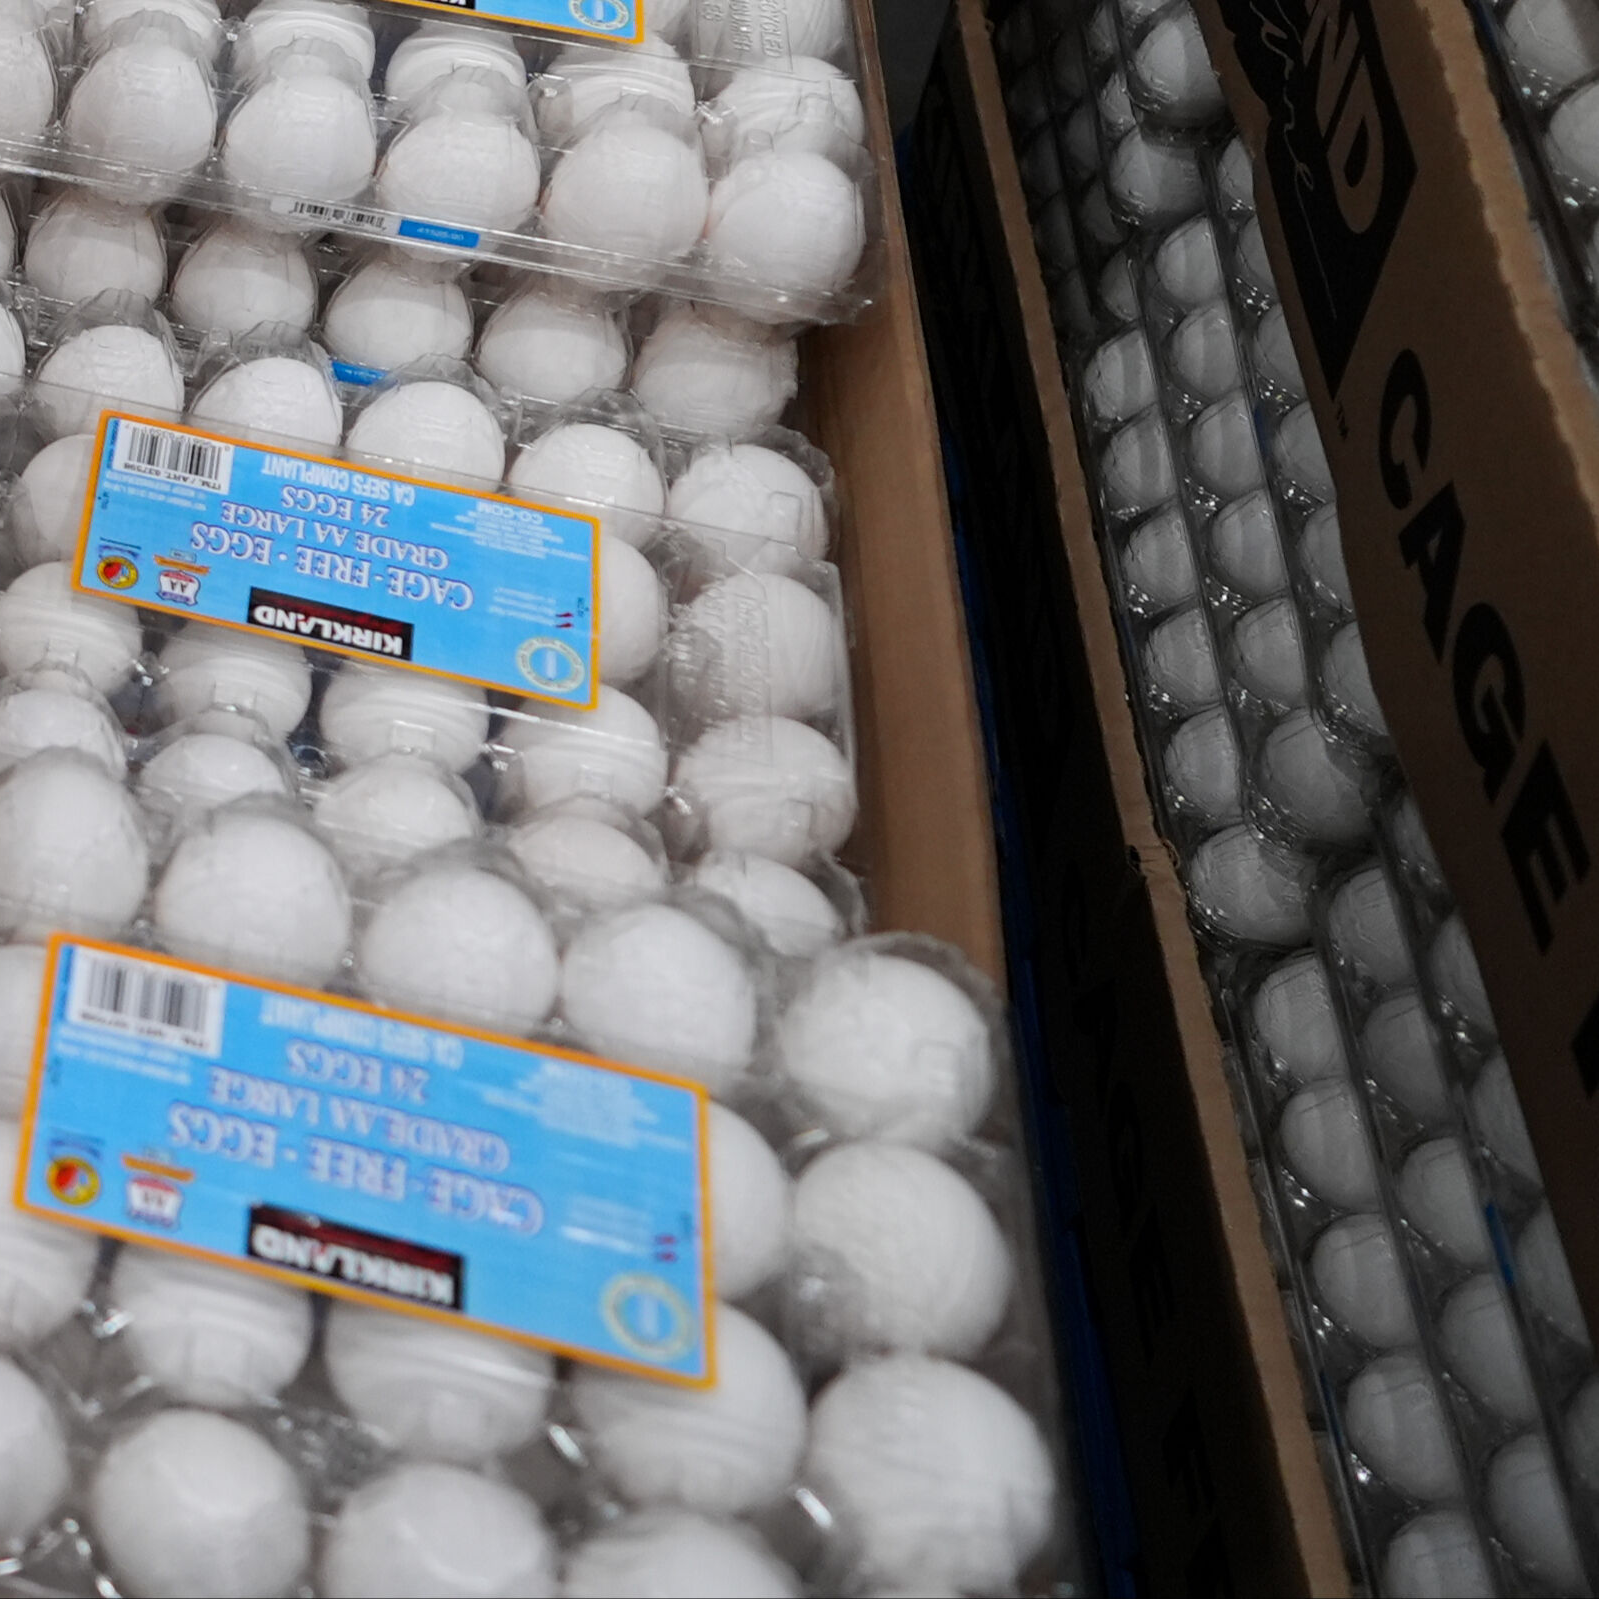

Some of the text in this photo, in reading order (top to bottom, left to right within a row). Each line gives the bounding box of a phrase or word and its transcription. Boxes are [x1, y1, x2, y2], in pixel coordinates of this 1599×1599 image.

[260, 452, 417, 506] CA SEFS COMPLIANT
[219, 500, 306, 541] LARGE
[280, 483, 391, 529] 24 EGGS
[188, 523, 272, 567] EGGS
[311, 520, 350, 549] AA
[352, 530, 448, 572] GRADE
[253, 604, 403, 656] KIRKLAND
[1376, 347, 1591, 956] CAGE
